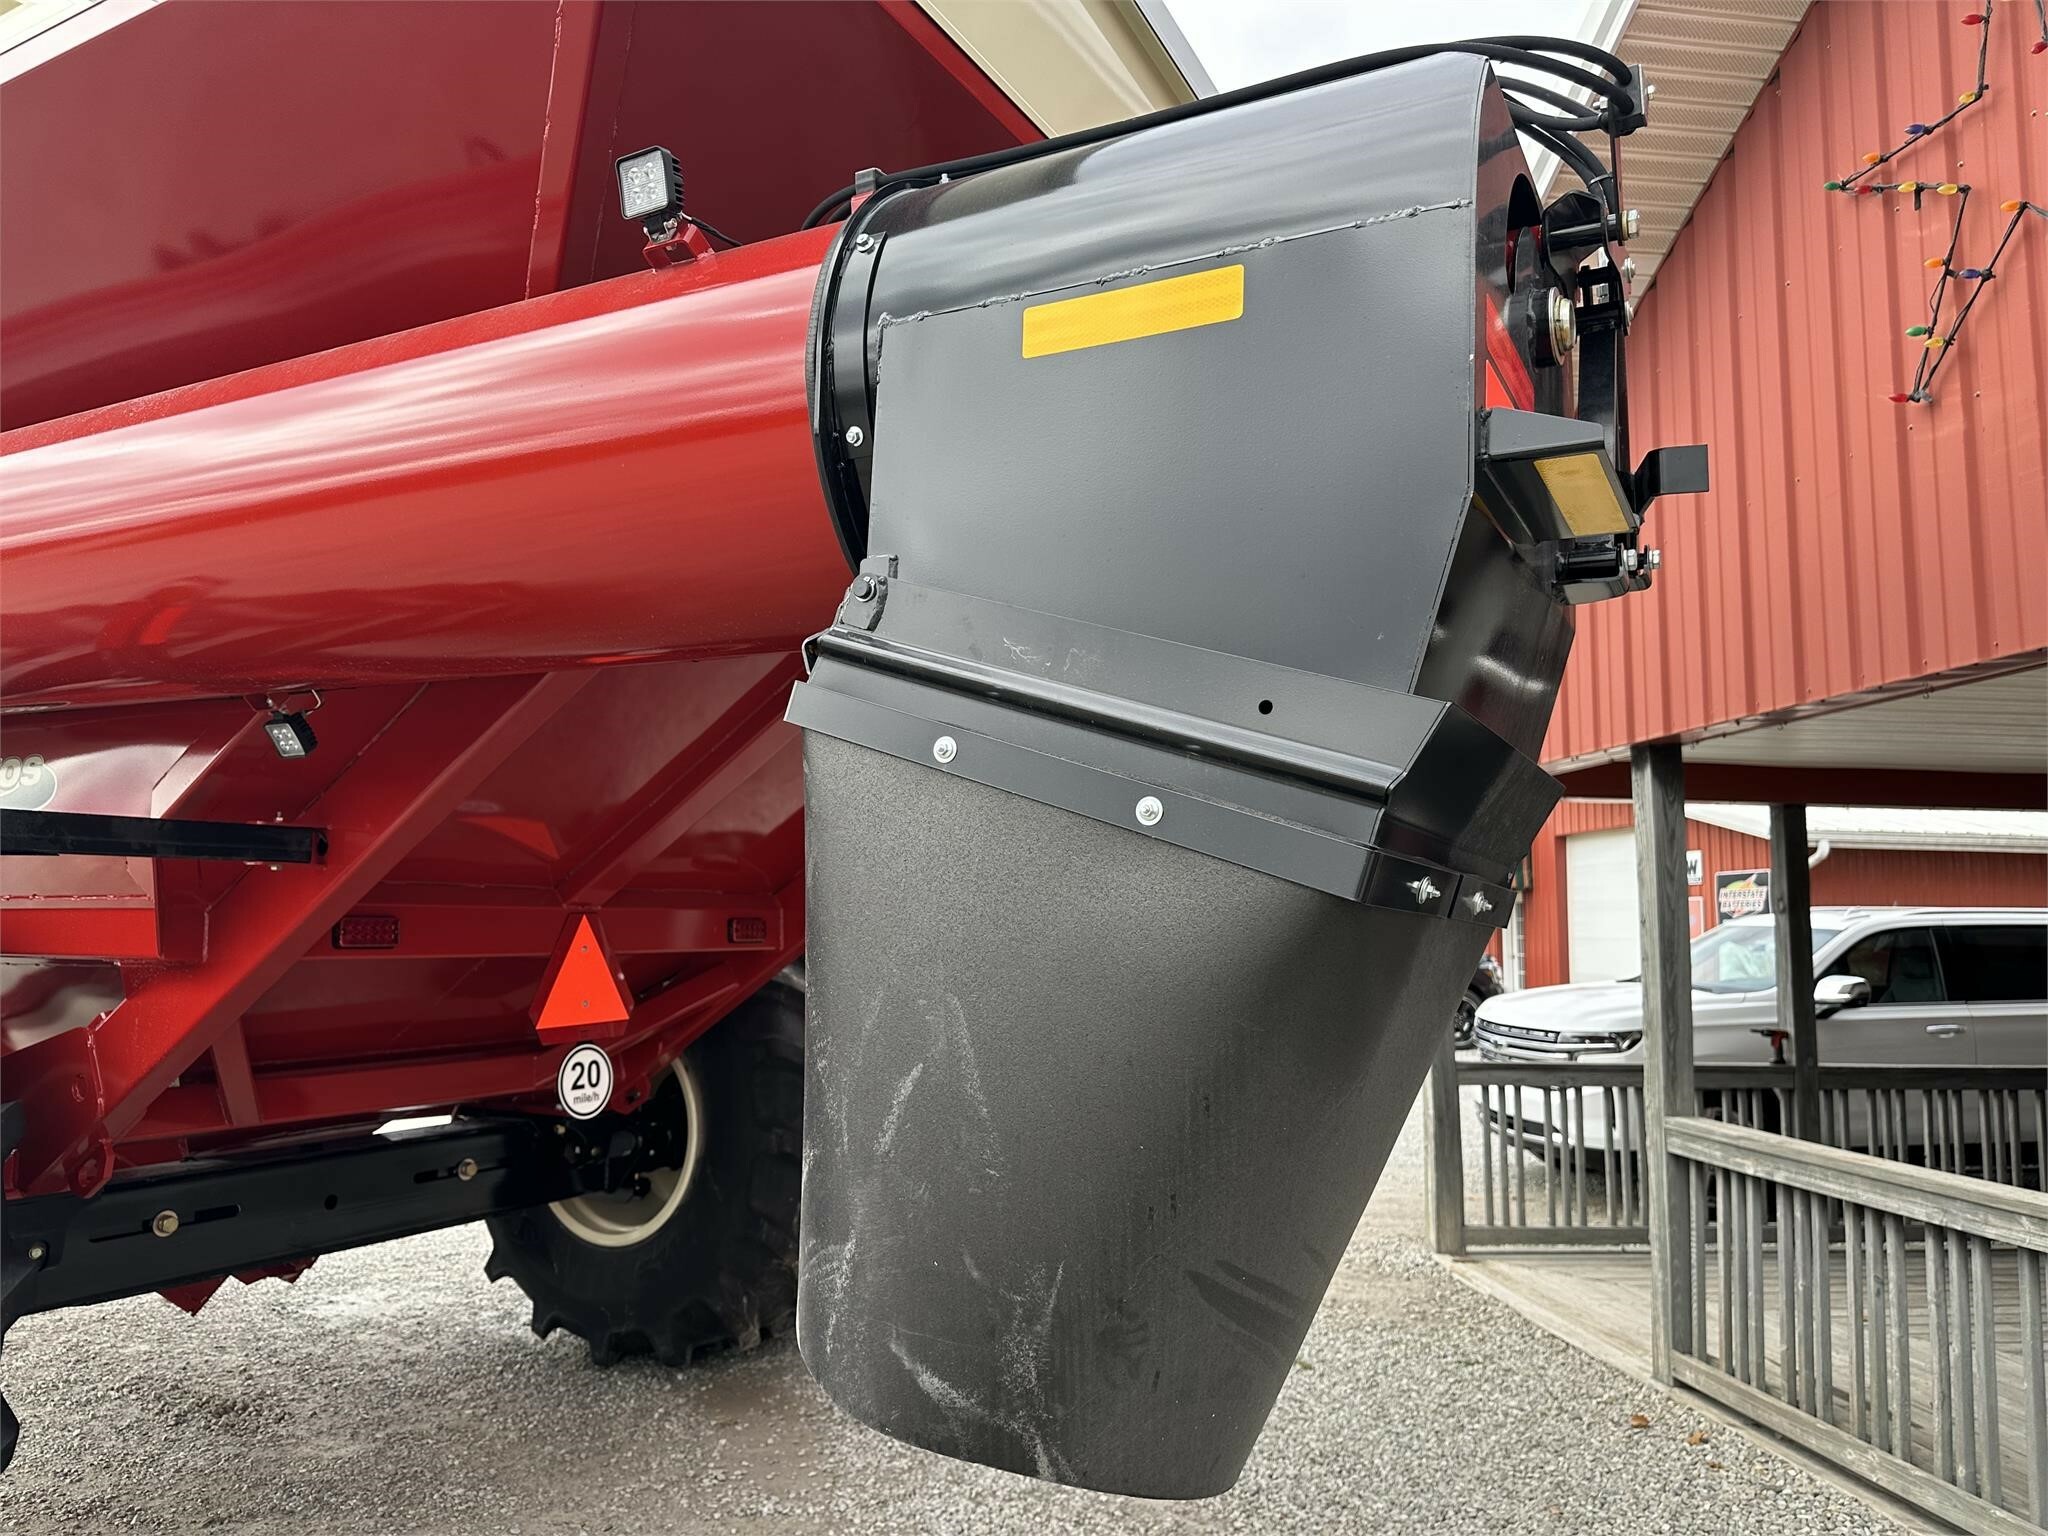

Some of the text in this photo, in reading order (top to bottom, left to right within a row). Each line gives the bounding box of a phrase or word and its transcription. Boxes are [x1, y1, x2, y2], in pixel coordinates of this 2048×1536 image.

[0, 757, 43, 788] os
[1720, 889, 1764, 900] INTERSTATE
[1722, 900, 1762, 908] BATTERIES
[571, 1060, 601, 1091] 20
[573, 1093, 600, 1104] mile/h
